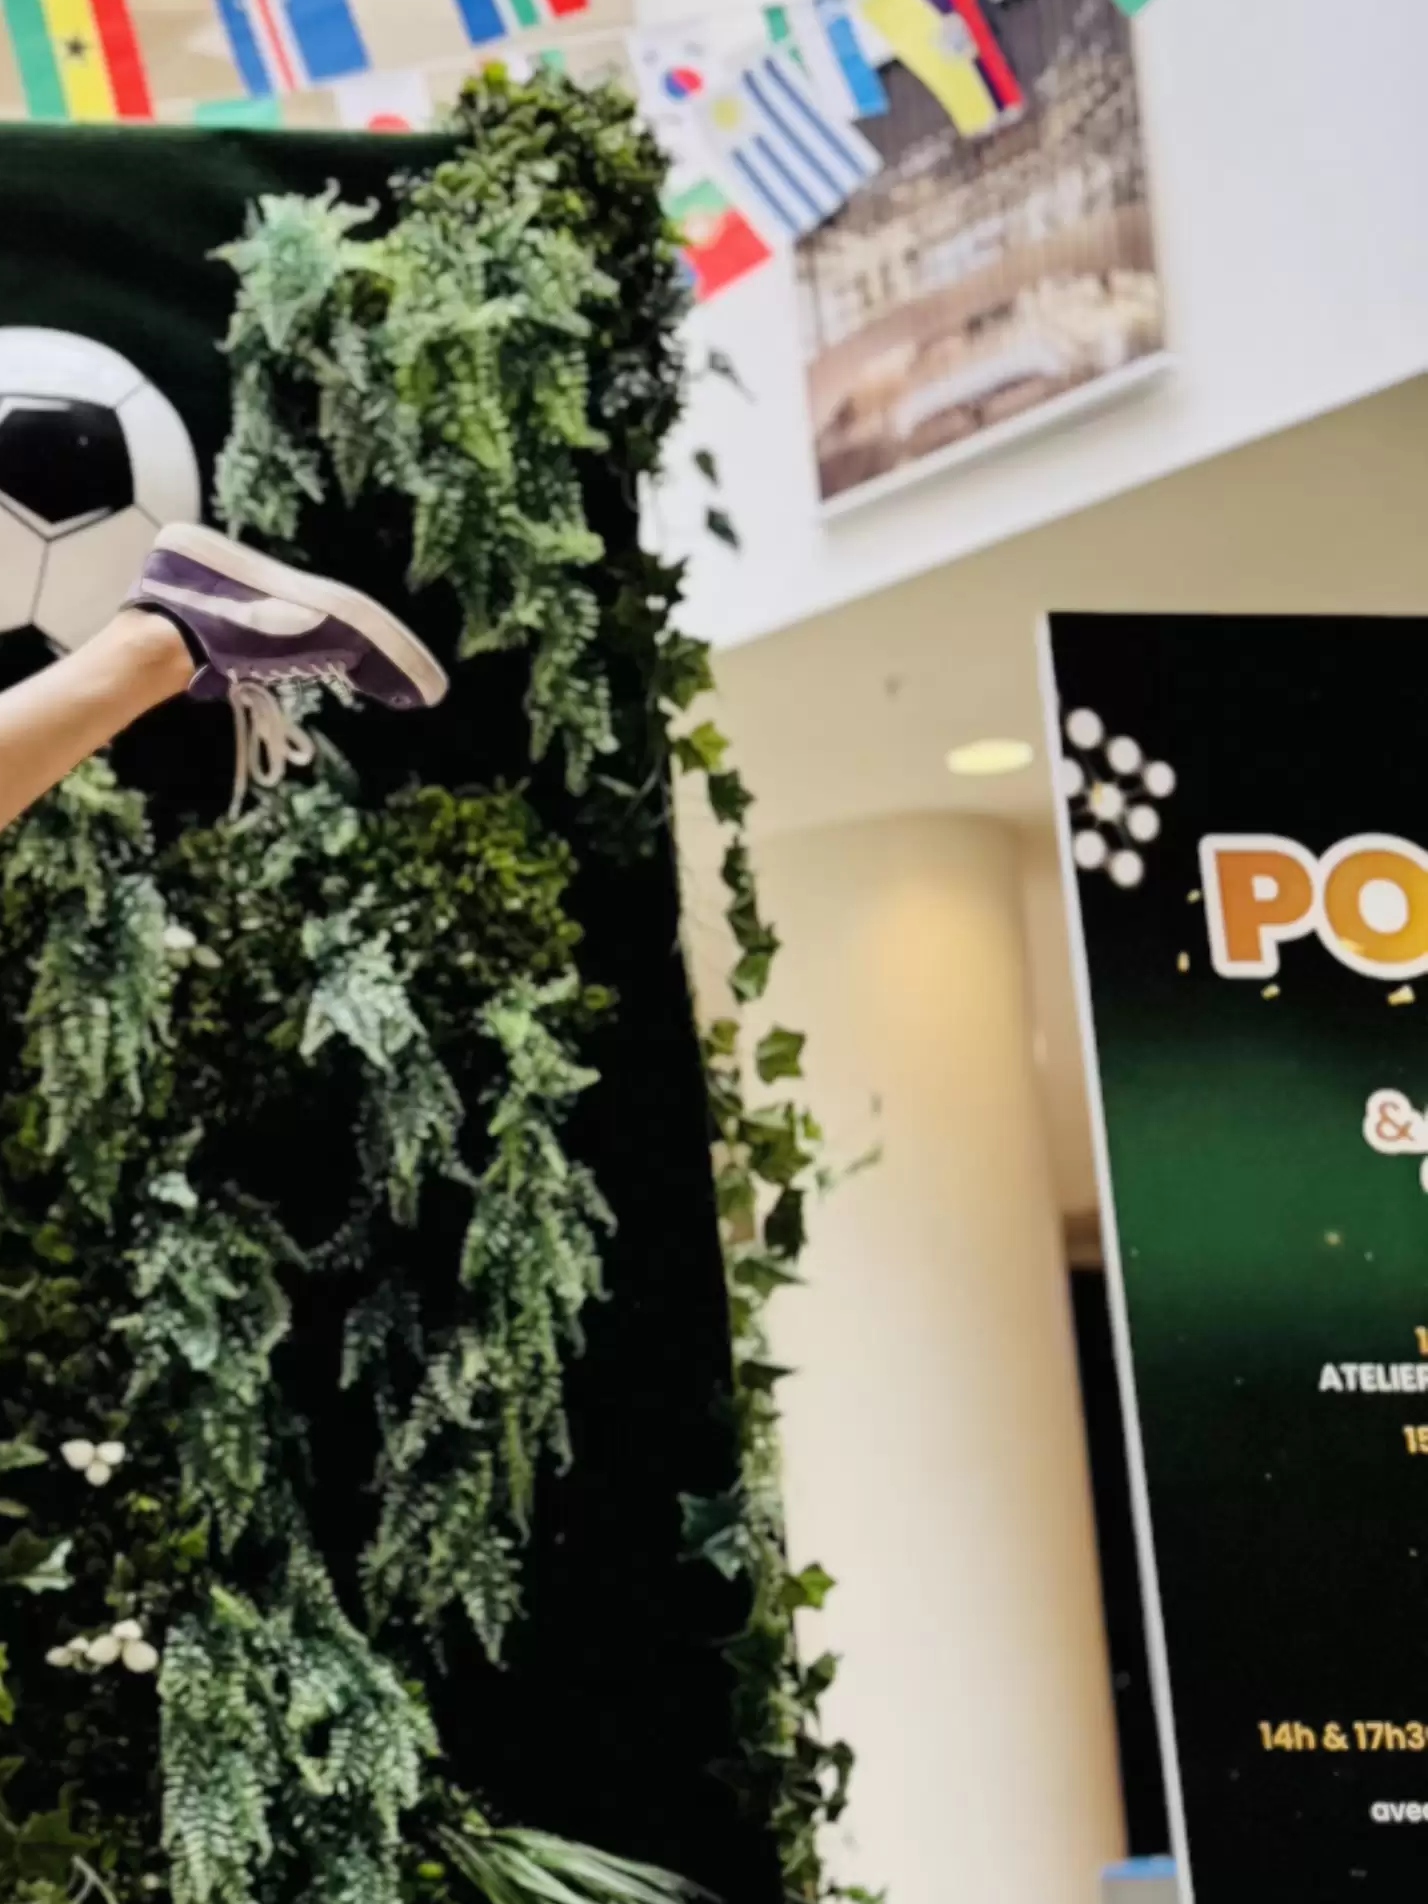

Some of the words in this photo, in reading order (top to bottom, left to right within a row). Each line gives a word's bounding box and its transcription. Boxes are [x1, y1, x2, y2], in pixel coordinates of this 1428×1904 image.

[1258, 1720, 1316, 1751] 14h
[1322, 1721, 1349, 1751] &
[1352, 1720, 1428, 1751] 17h3
